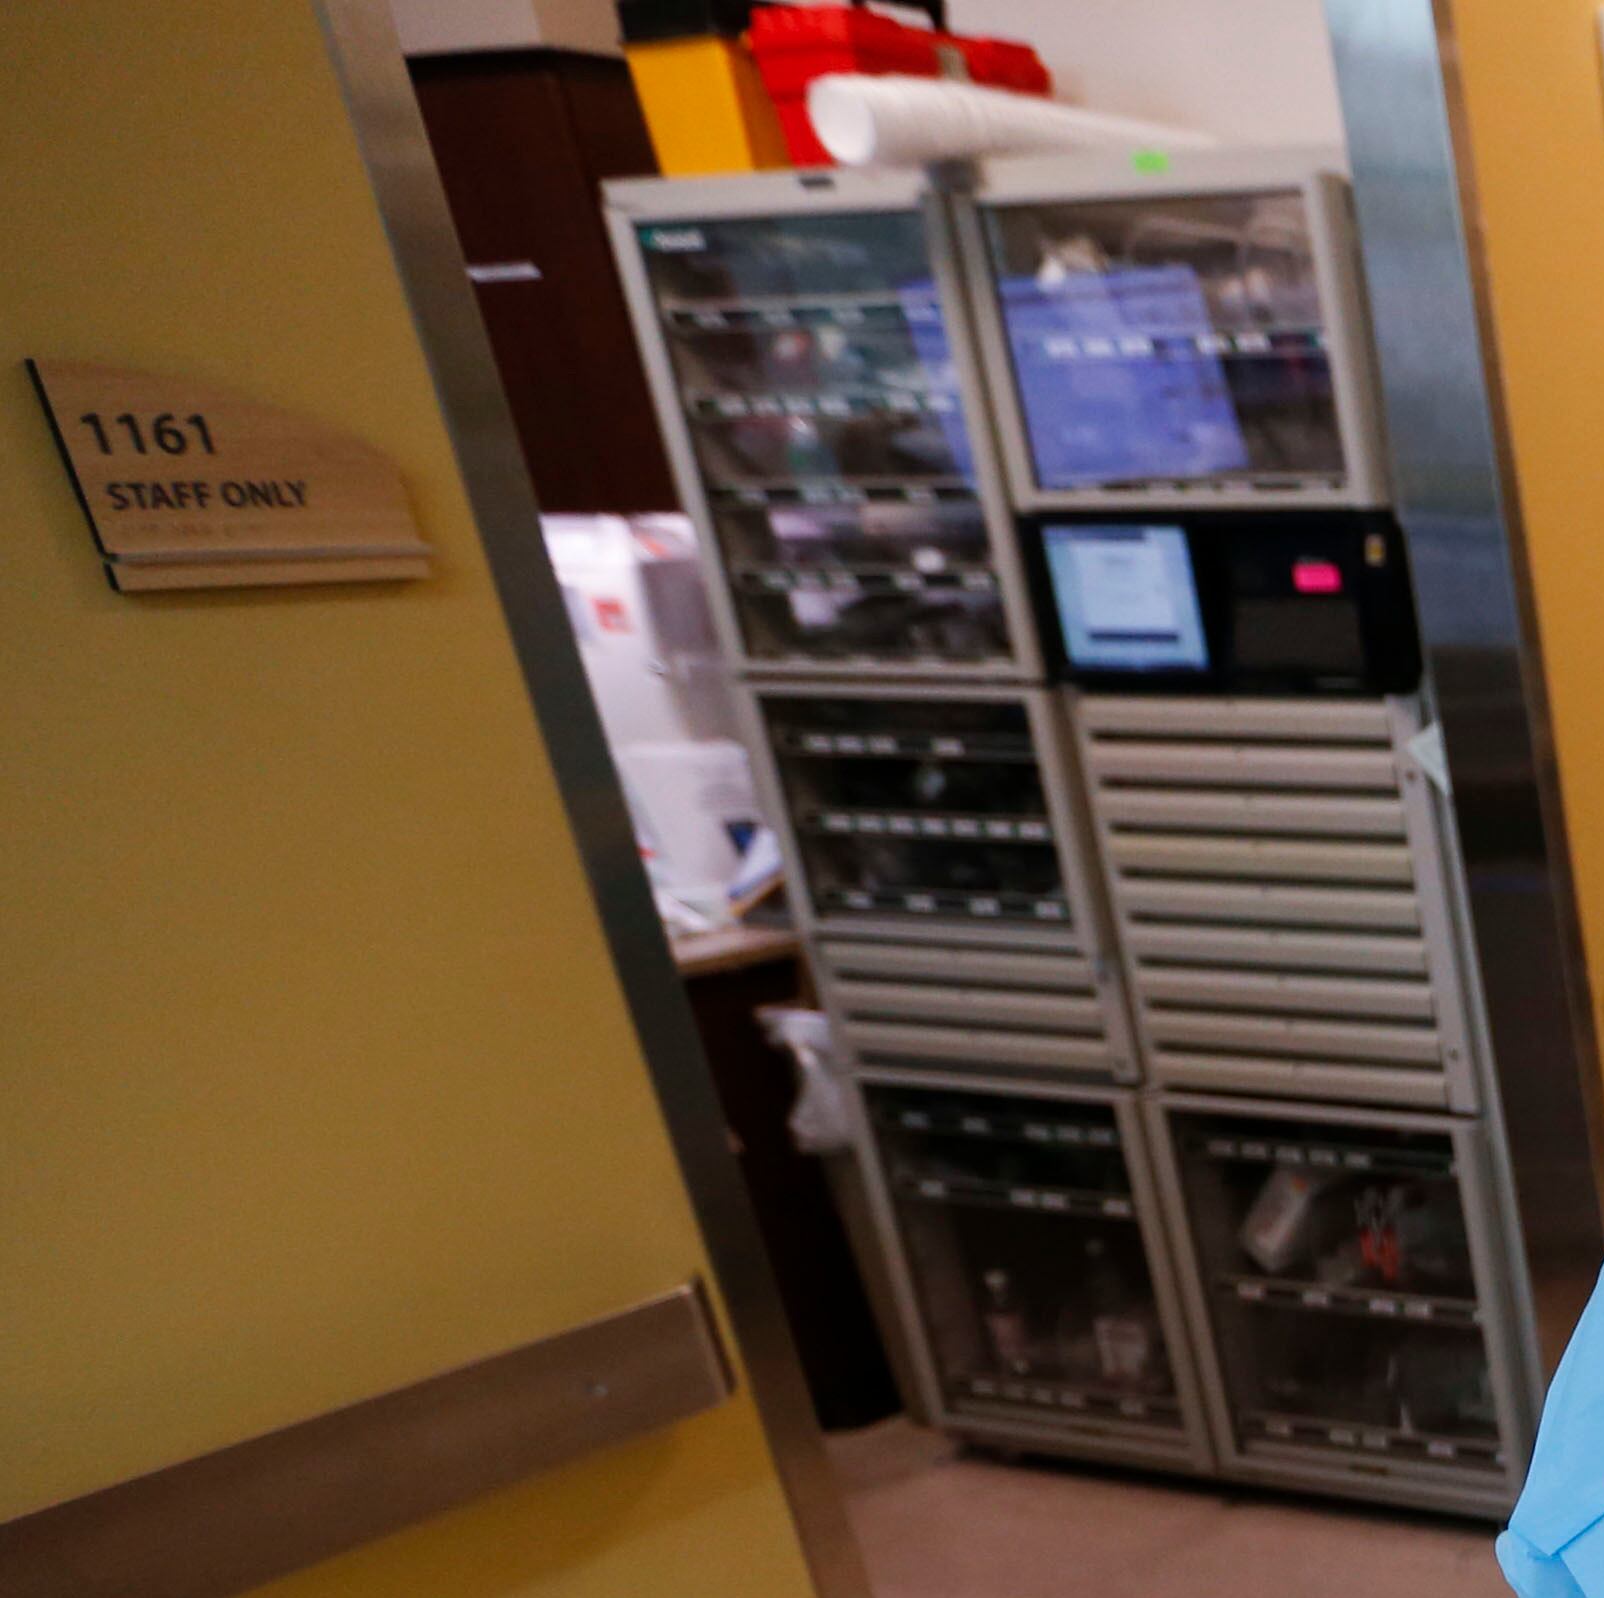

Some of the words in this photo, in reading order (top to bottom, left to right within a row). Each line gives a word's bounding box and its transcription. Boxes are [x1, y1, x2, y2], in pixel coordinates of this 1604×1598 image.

[80, 412, 216, 455] 1161
[105, 481, 210, 510] STAFF
[220, 481, 308, 508] ONLY
